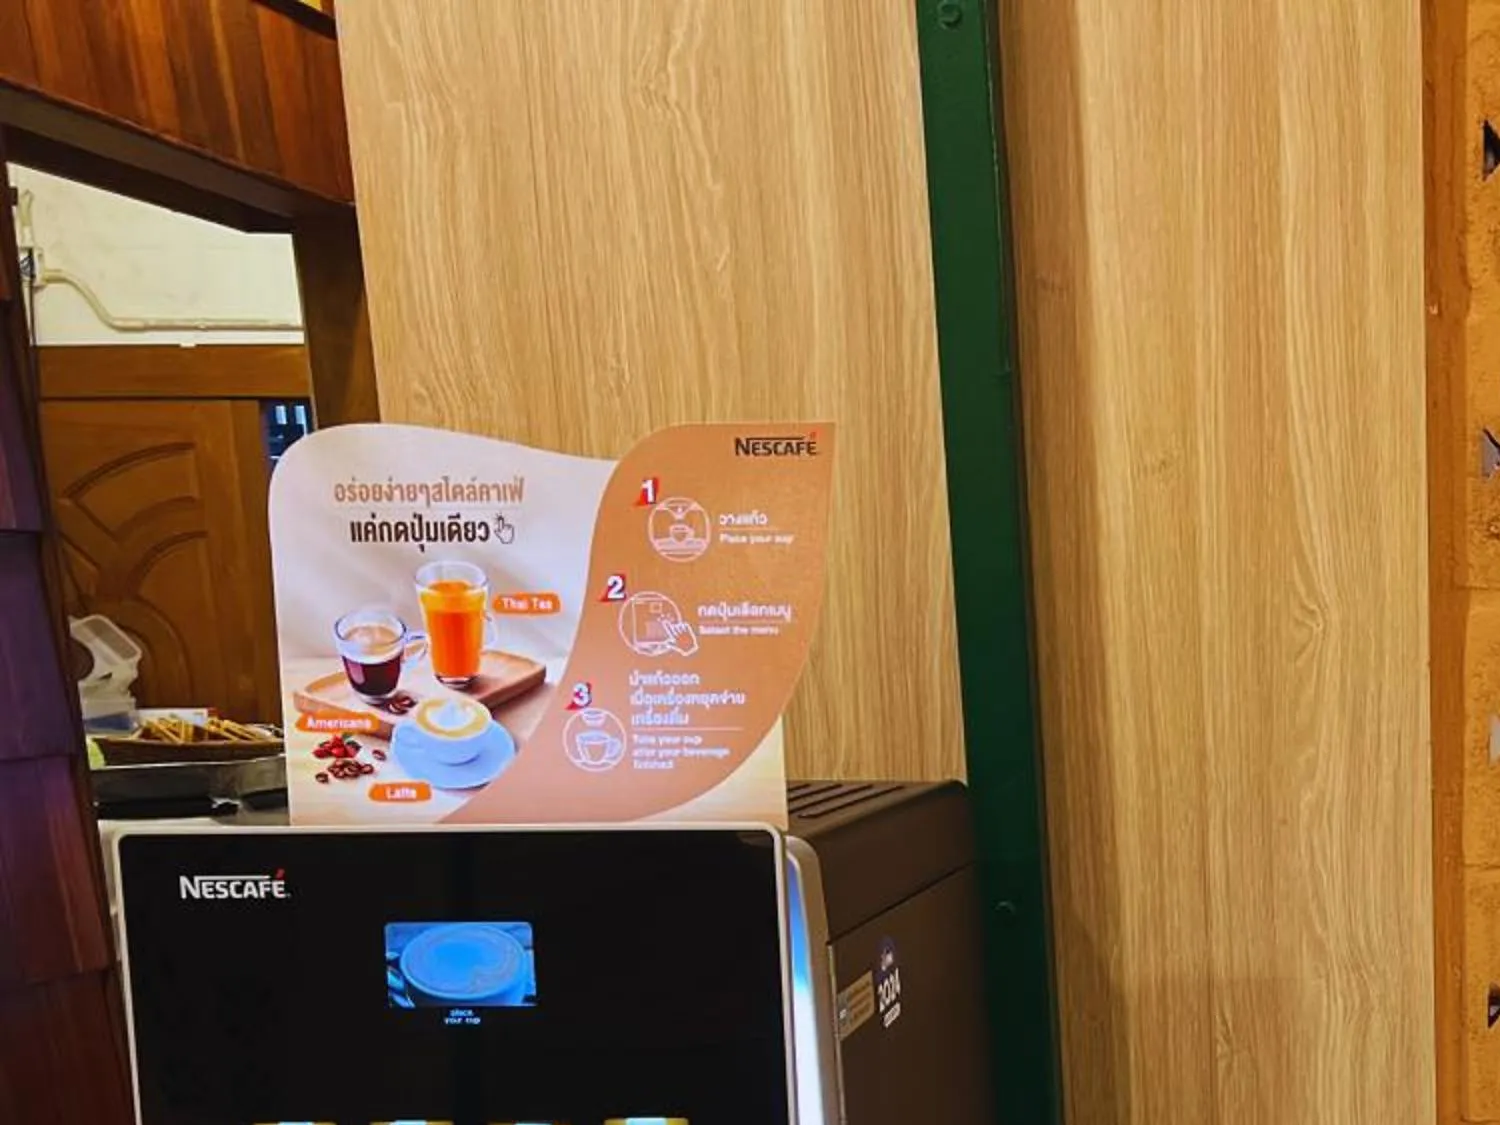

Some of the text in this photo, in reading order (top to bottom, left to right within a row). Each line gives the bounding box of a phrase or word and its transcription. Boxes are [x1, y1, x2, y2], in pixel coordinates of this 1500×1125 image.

[641, 479, 656, 504] 1
[350, 512, 490, 552] แค่กดปุ่มเดียว
[607, 575, 626, 600] 2
[573, 682, 592, 706] 3
